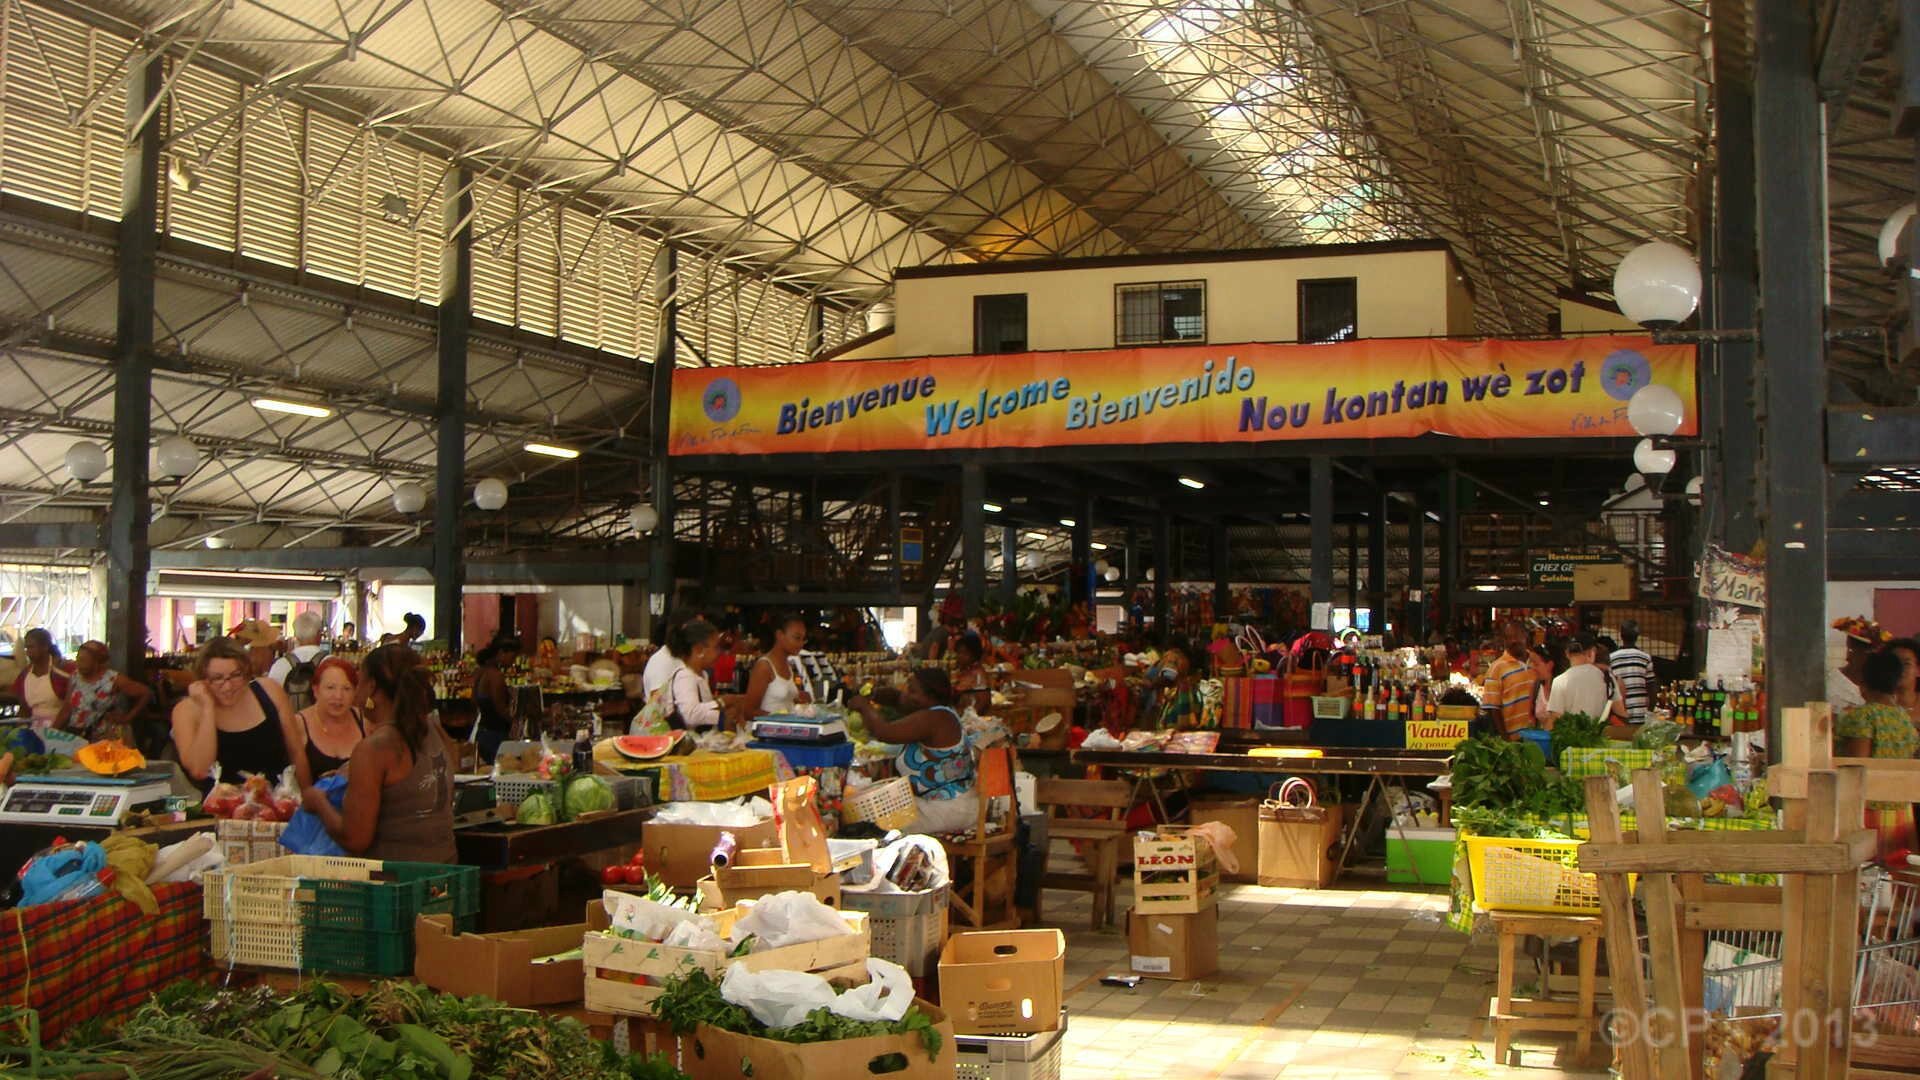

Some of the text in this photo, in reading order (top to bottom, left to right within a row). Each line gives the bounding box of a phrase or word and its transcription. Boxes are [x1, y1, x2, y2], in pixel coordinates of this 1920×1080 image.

[777, 375, 936, 435] Bienvenue
[925, 376, 1070, 437] Welcome
[1065, 356, 1254, 430] Bienvenido
[1239, 360, 1585, 431] Nou kontan wè zot
[1533, 563, 1559, 572] CHEZ
[1408, 723, 1466, 738] Vanille
[1137, 855, 1194, 865] LEON
